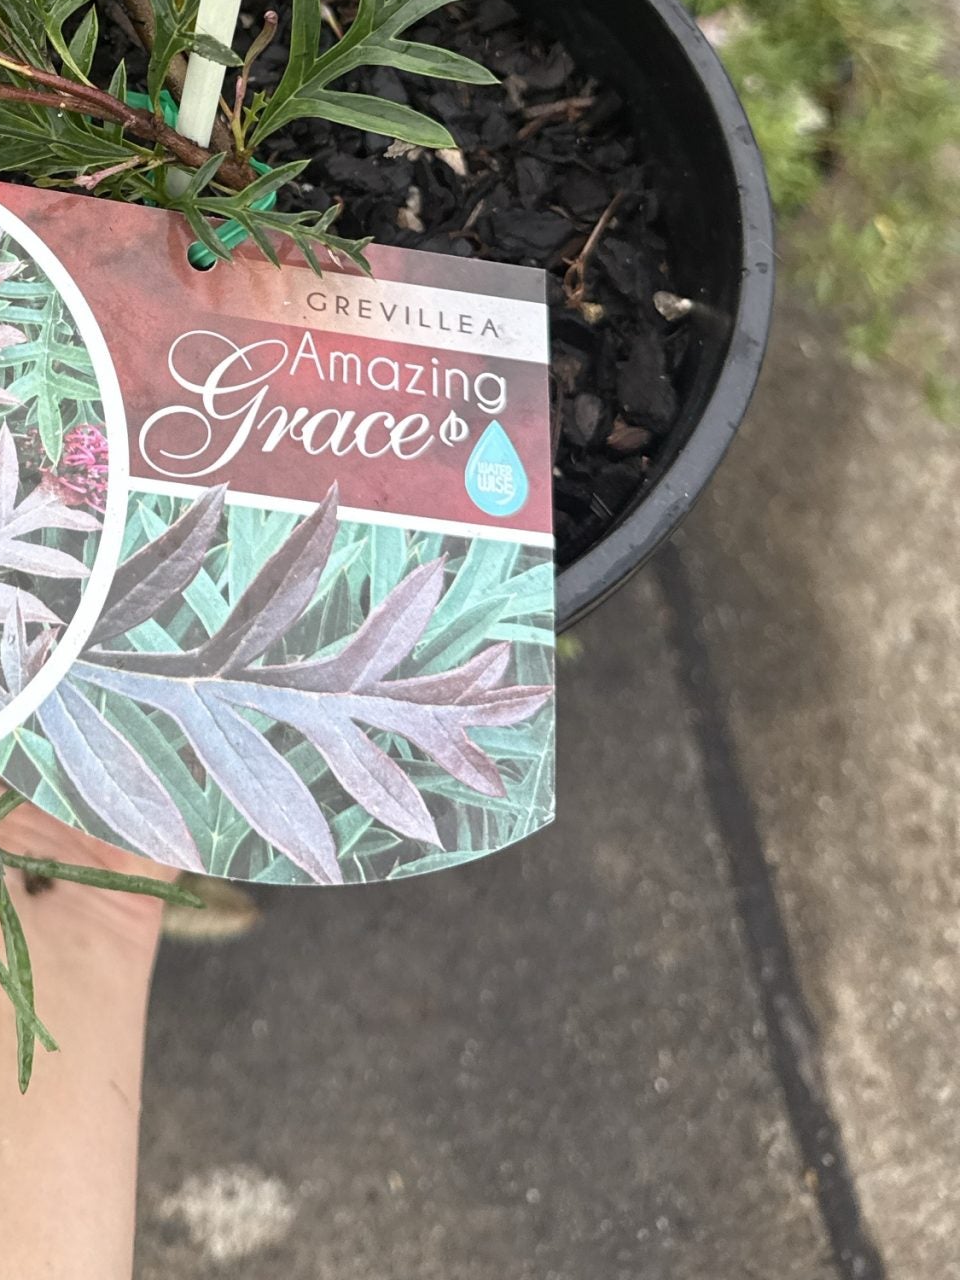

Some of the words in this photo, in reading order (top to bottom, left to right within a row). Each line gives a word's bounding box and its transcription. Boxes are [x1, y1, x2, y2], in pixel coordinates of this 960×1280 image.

[306, 292, 500, 338] GREVILLEA
[290, 331, 507, 414] Amazing
[139, 329, 435, 478] Grace
[477, 461, 513, 478] WATER
[477, 476, 515, 495] WISE
